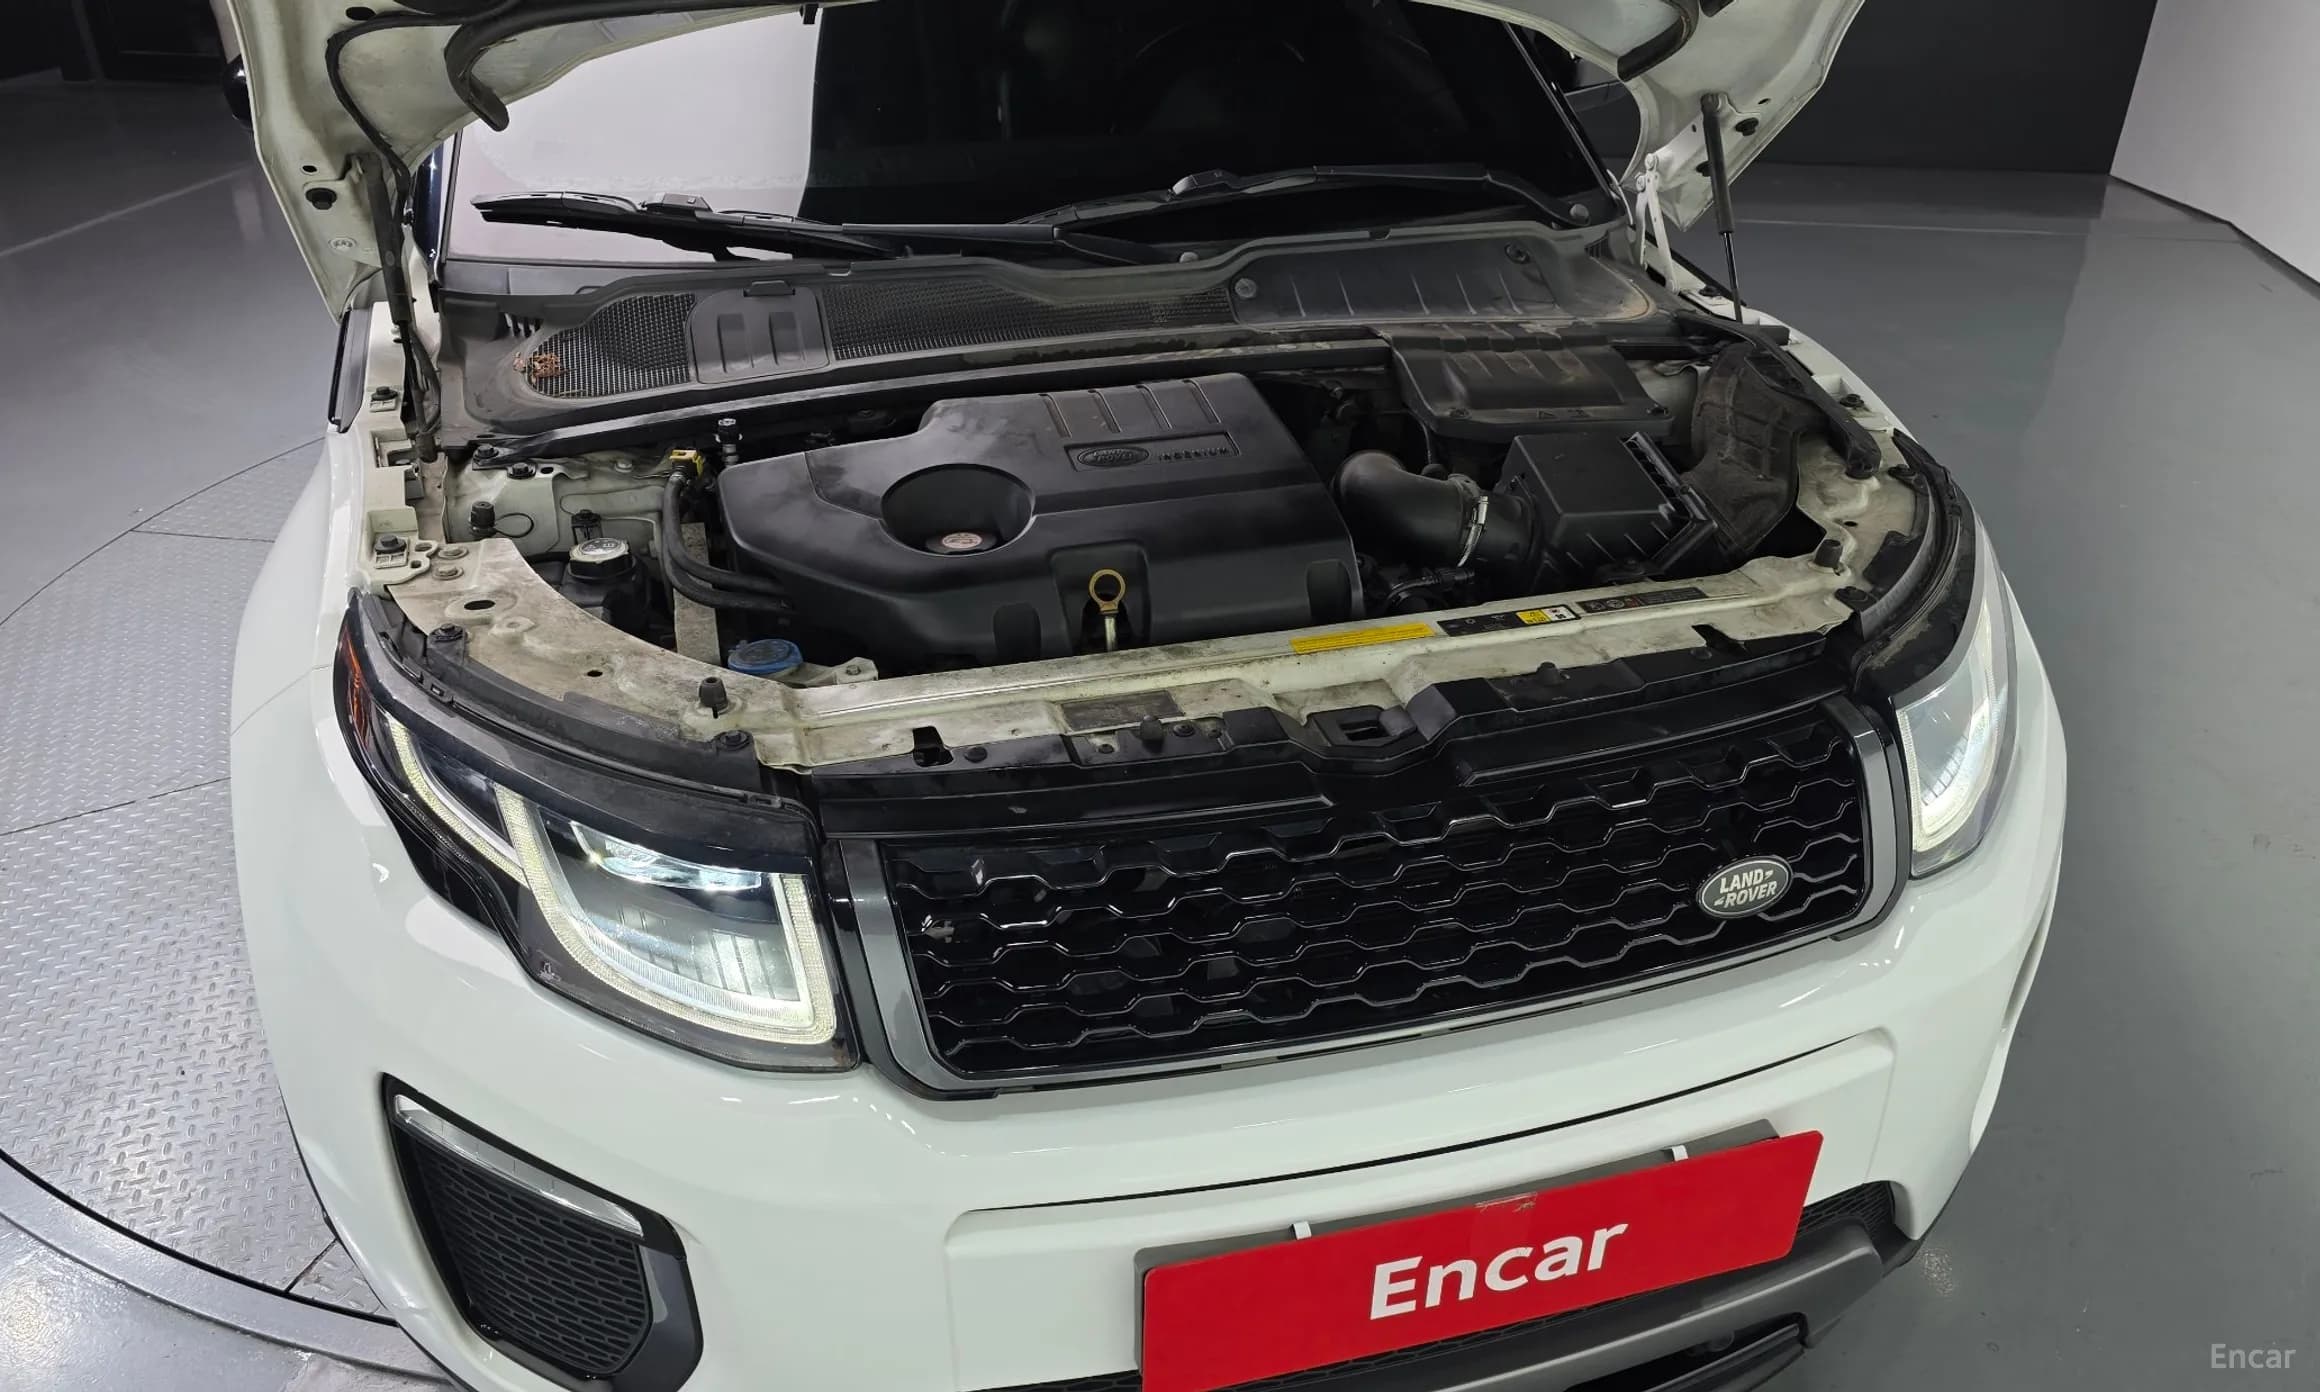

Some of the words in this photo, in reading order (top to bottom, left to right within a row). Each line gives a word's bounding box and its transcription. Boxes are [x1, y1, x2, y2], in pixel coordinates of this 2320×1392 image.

[1719, 868, 1764, 894] LAND
[1724, 881, 1778, 908] ROVER
[1370, 1222, 1629, 1320] Encar
